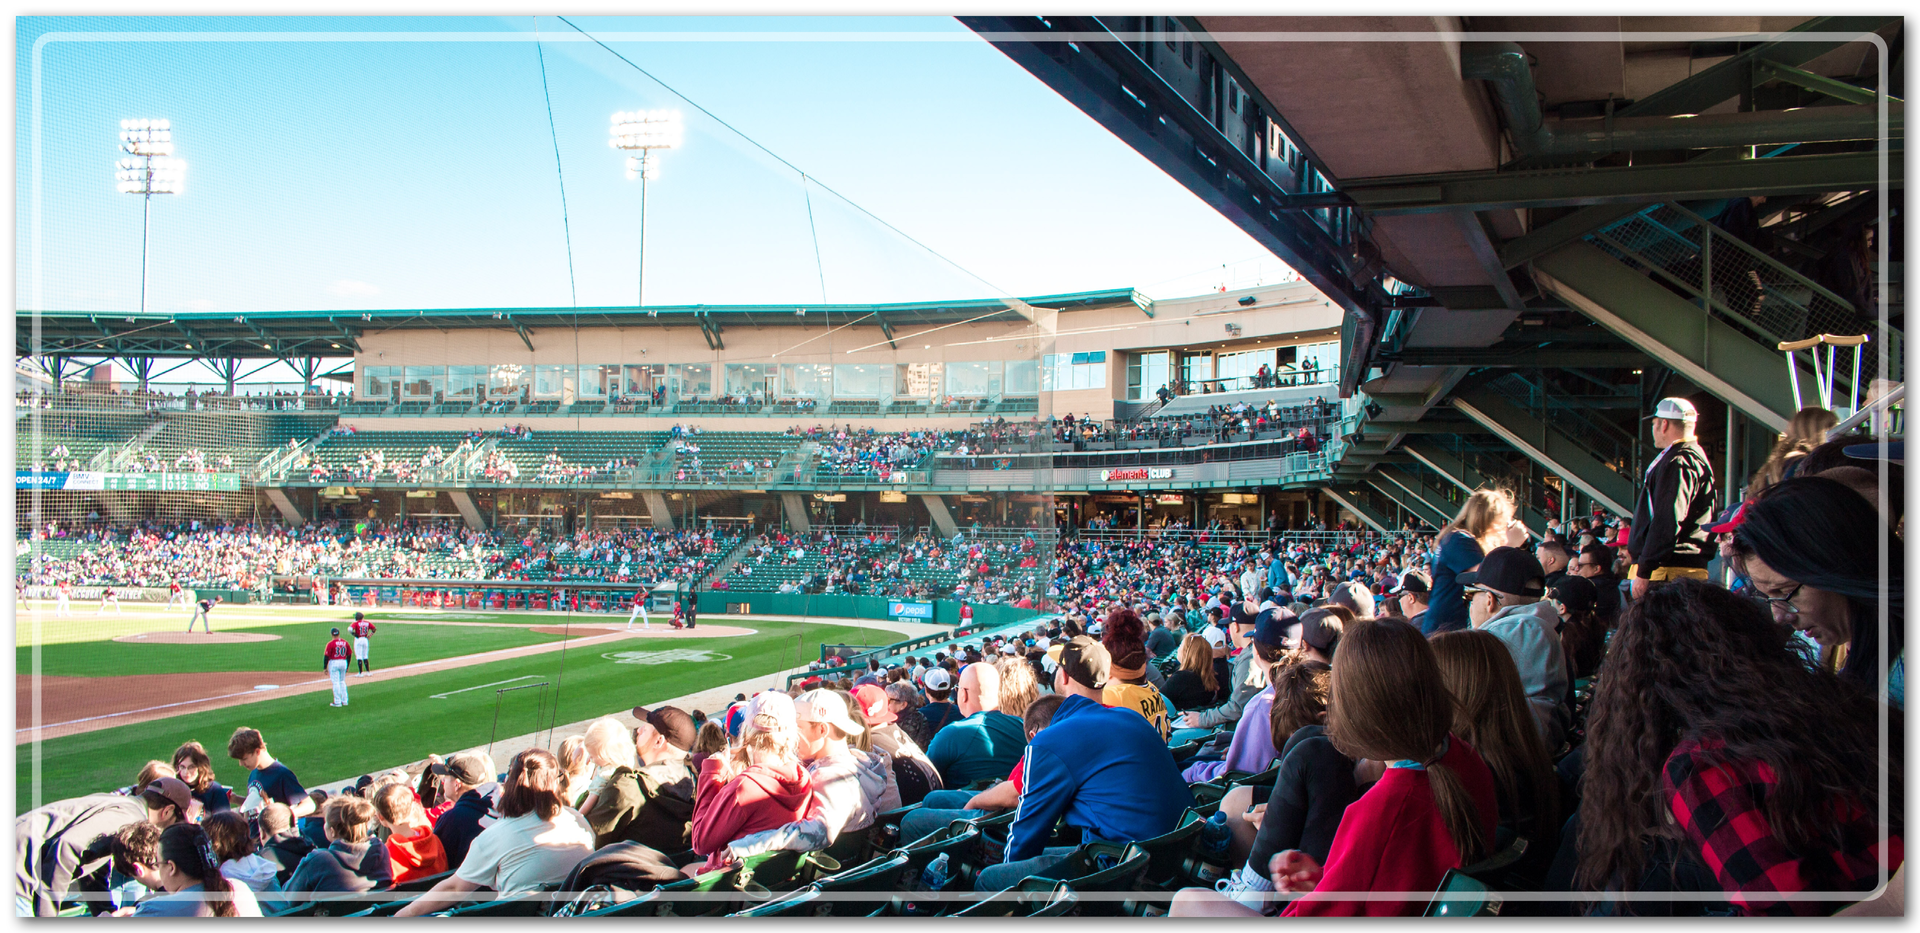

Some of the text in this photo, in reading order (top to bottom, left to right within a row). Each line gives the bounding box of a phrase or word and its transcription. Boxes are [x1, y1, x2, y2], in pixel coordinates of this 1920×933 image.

[193, 473, 209, 481] LOU
[1109, 468, 1172, 480] elements CLUB
[16, 476, 57, 485] OPEN 24/7
[195, 482, 209, 490] IND
[905, 606, 926, 615] pepsi
[334, 646, 347, 657] 30
